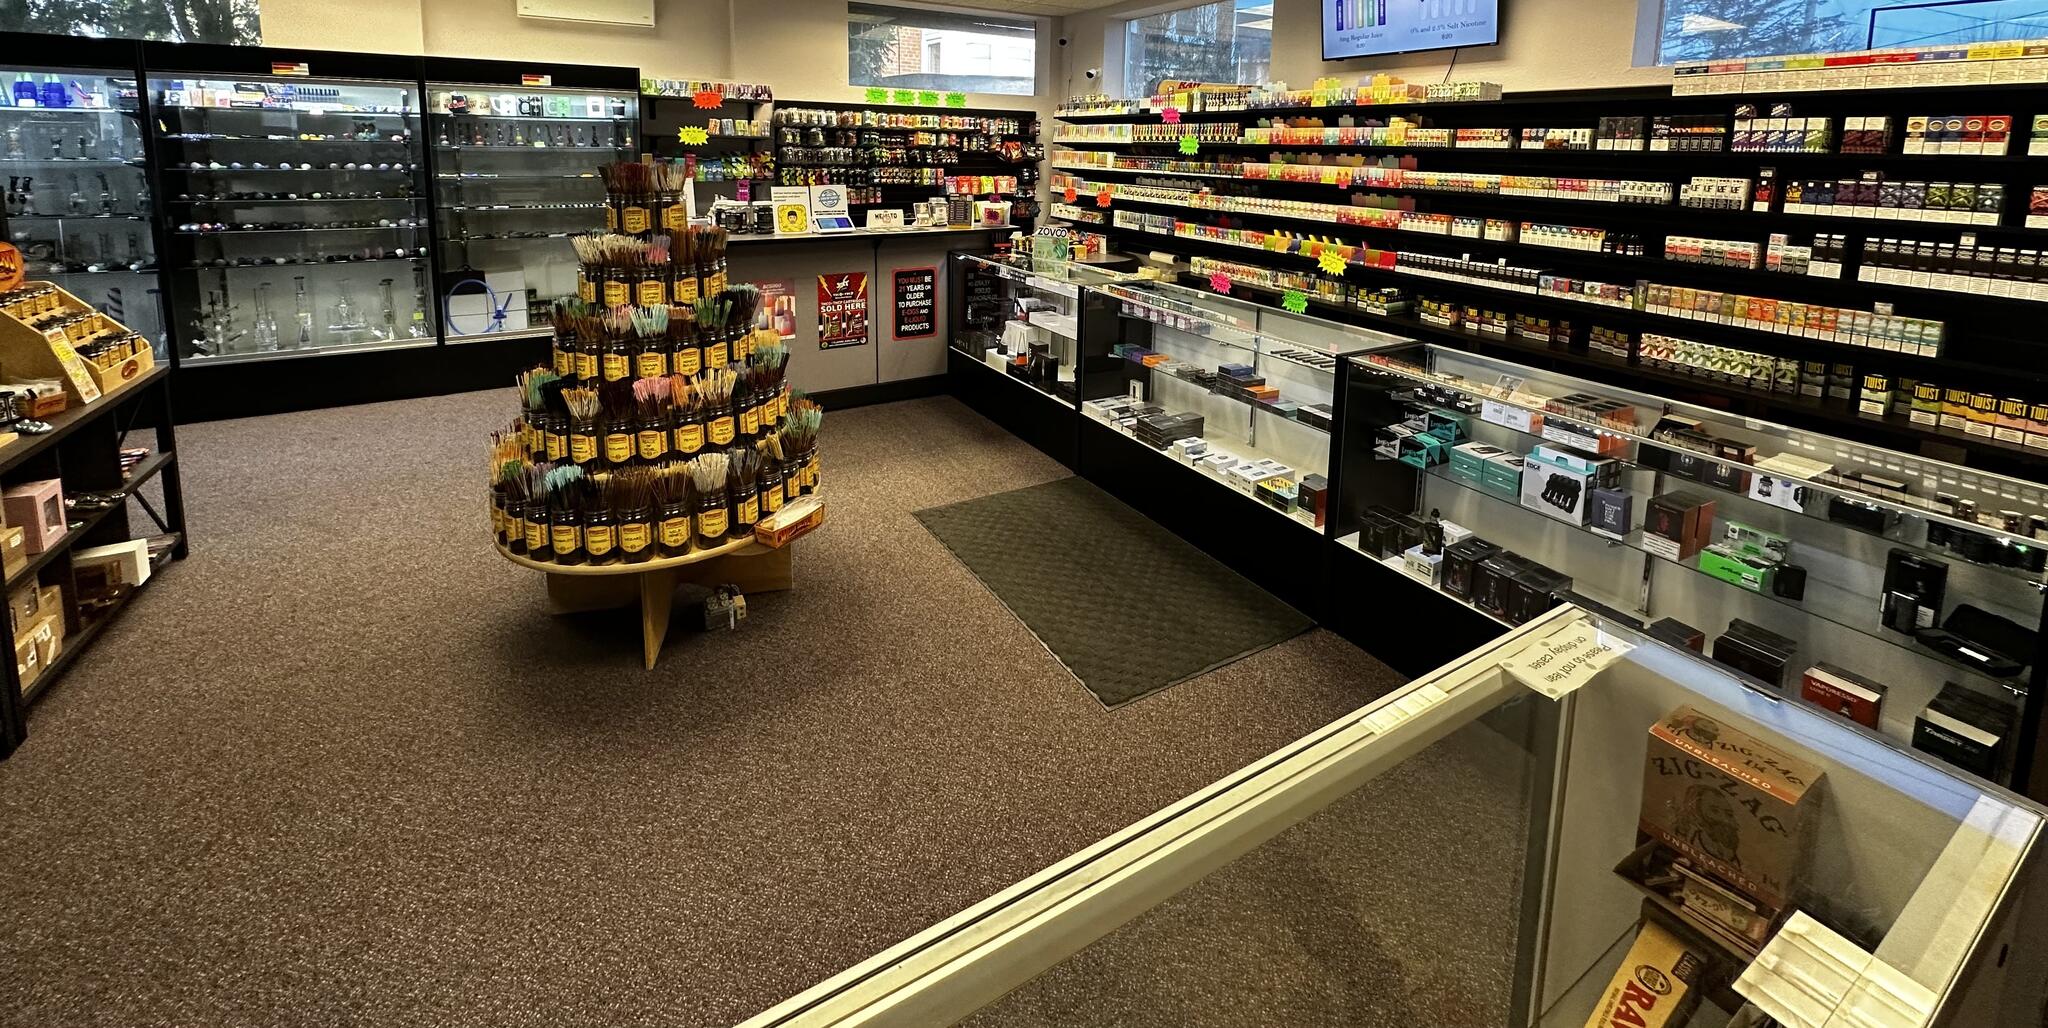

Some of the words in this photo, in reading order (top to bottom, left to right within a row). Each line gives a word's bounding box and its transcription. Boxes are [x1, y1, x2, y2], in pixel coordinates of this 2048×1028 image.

[906, 299, 932, 308] PURCHASE
[901, 323, 929, 331] PRODUCTS
[1864, 376, 1888, 390] TWIST
[1915, 385, 1940, 400] TWIST
[1945, 389, 1970, 404] TWIST
[1970, 395, 1997, 410] TWIST
[2000, 400, 2028, 416] TWIST
[2030, 406, 2048, 421] TWI
[1575, 636, 1587, 644] on
[1549, 641, 1578, 656] display
[1585, 643, 1612, 658] Please
[1560, 660, 1576, 675] not
[1573, 656, 1586, 664] do
[1544, 672, 1567, 682] lean
[1811, 680, 1856, 702] VAPORESSO
[1675, 738, 1771, 790] UNBLEACHED
[1716, 741, 1806, 787] ZIG-ZAG
[1651, 757, 1789, 837] ZIG-ZAG
[1662, 832, 1757, 892] UNBLEACHED
[1610, 979, 1657, 1028] RA
